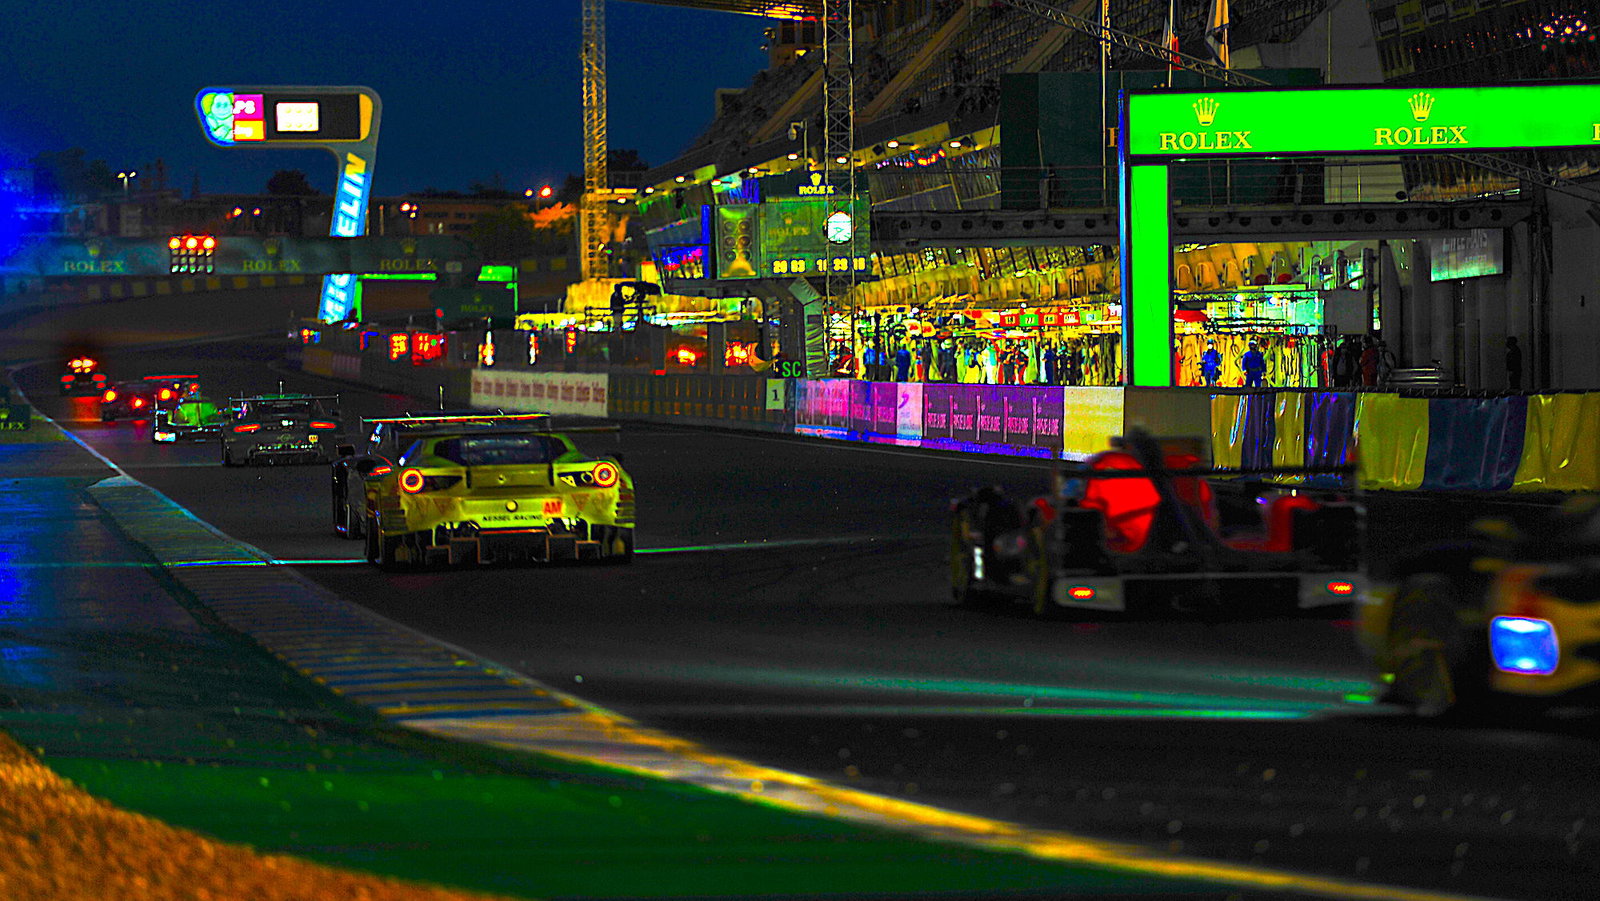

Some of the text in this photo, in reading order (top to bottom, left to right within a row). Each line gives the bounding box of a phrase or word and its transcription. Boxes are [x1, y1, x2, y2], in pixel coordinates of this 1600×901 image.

[1160, 131, 1252, 150] ROLEX
[1373, 126, 1468, 145] ROLEX
[798, 186, 834, 194] ROLEX
[63, 260, 124, 272] ROLEX
[242, 260, 301, 272] ROLEX
[379, 259, 438, 271] ROLEX
[781, 361, 802, 378] SC
[771, 389, 780, 402] 1
[544, 501, 562, 514] AM
